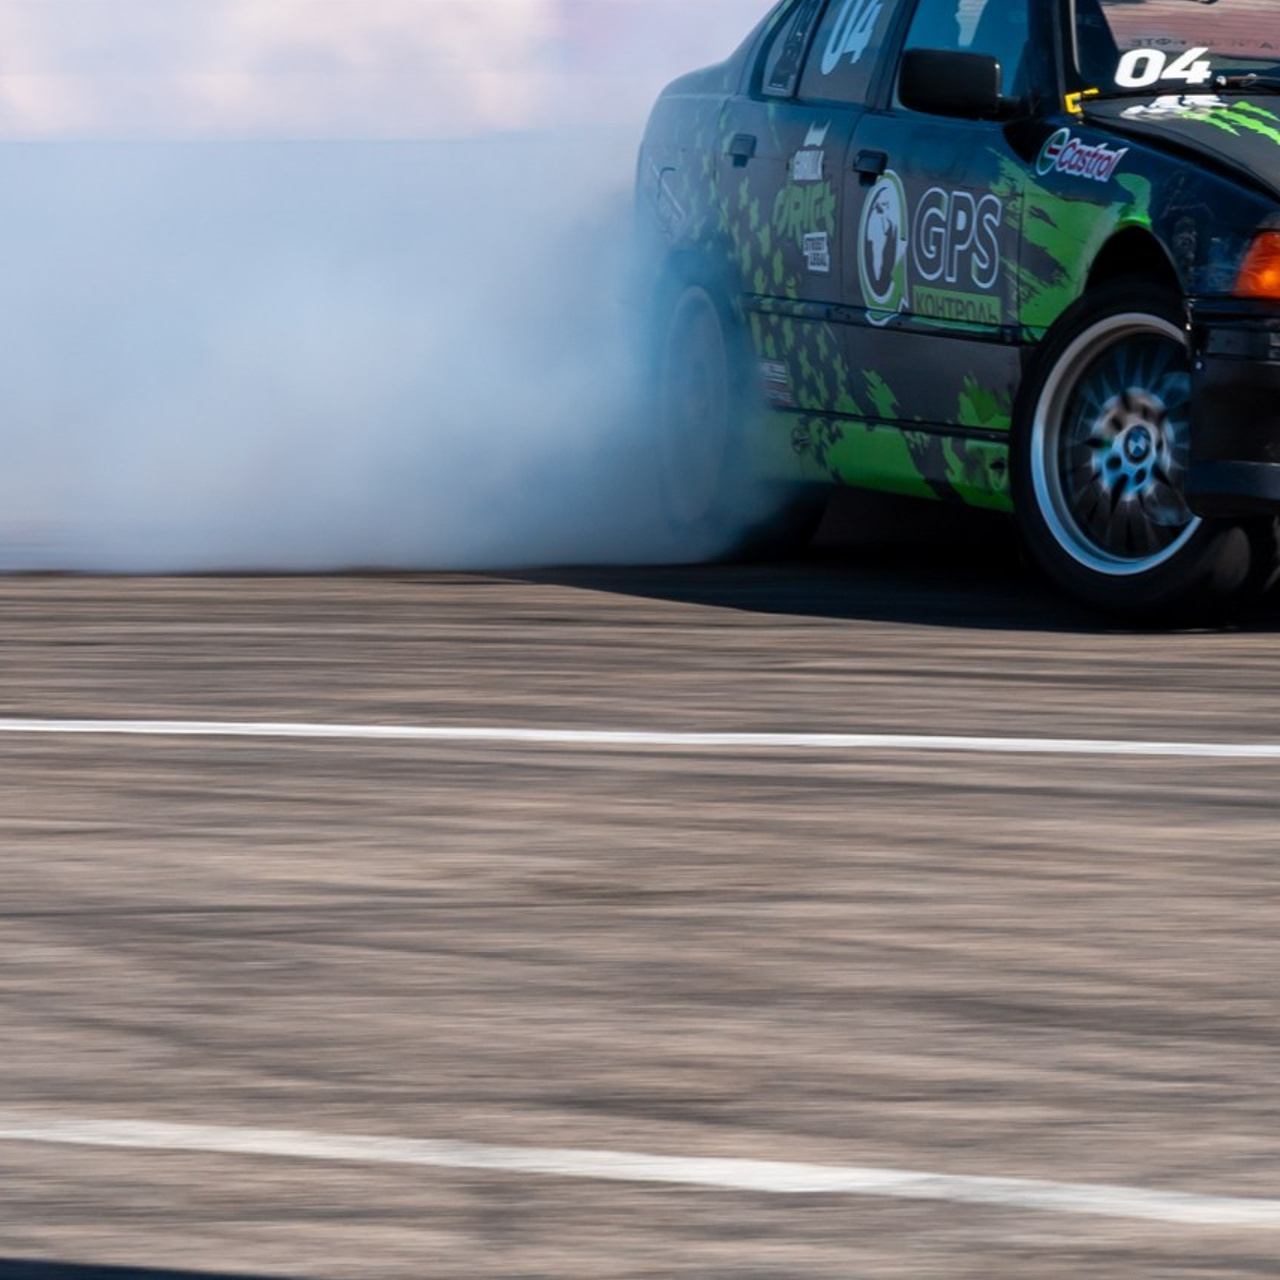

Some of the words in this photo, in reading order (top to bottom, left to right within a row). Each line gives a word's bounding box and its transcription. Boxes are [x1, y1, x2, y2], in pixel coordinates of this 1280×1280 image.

[1114, 47, 1212, 88] 04
[1057, 137, 1130, 183] Castrol
[912, 187, 1002, 289] GPS
[915, 291, 999, 323] КОНТРОЛЬ
